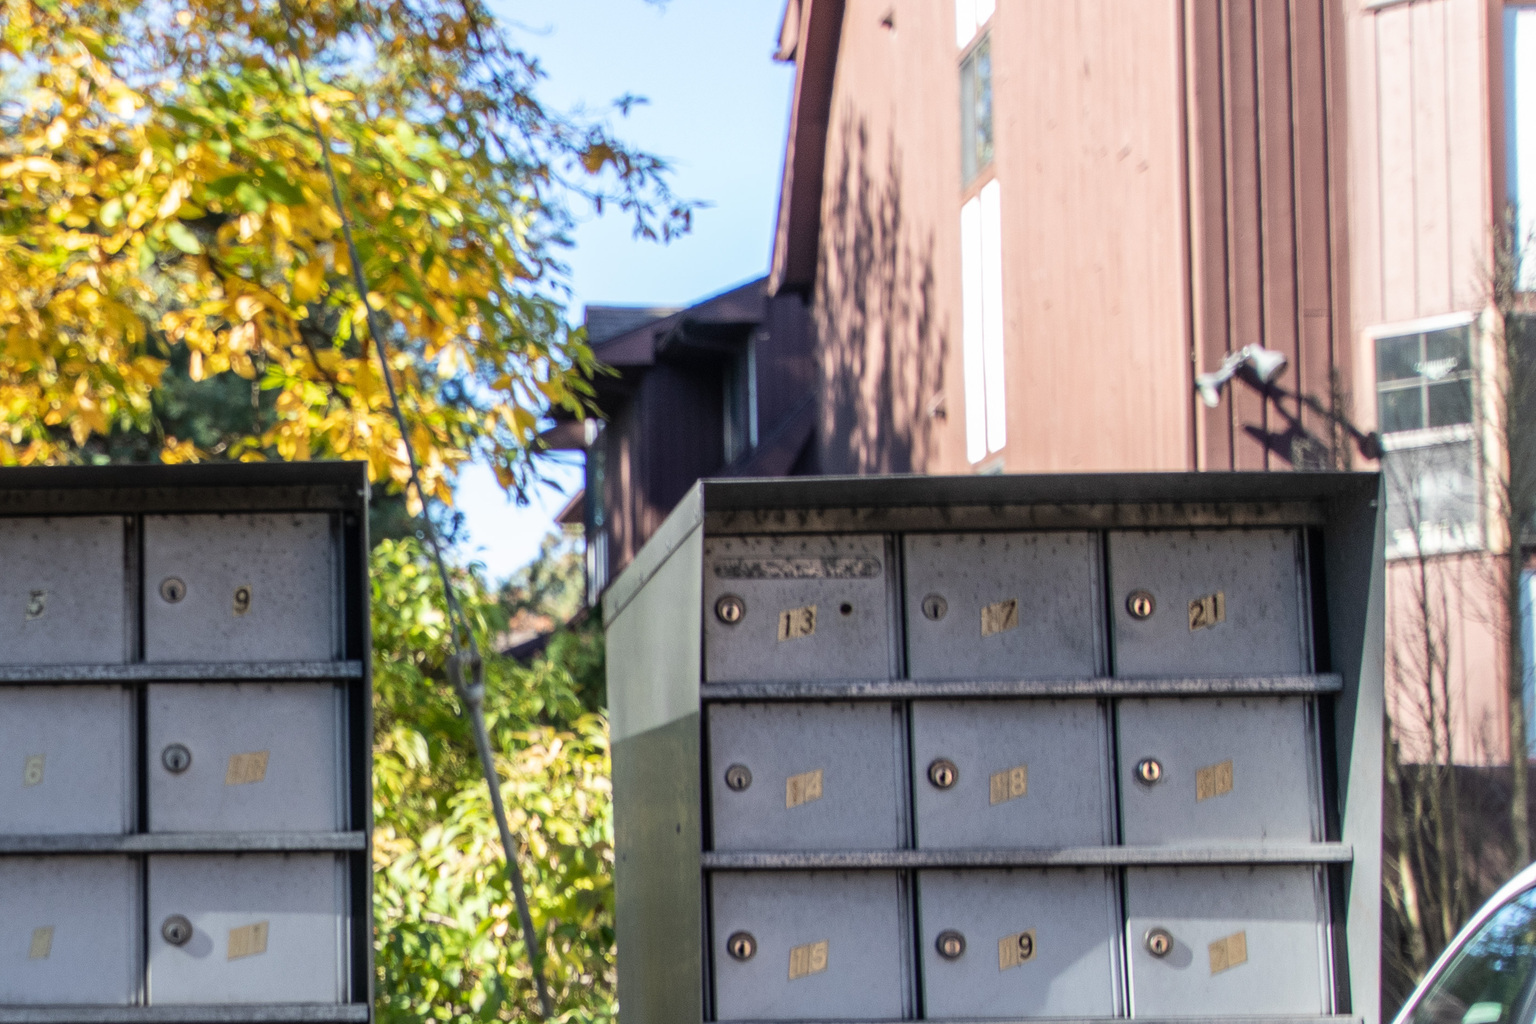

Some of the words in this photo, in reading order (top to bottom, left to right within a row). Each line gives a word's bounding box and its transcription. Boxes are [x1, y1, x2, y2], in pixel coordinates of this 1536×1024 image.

[233, 586, 251, 615] 9
[1190, 593, 1219, 629] 21
[783, 605, 815, 638] 13
